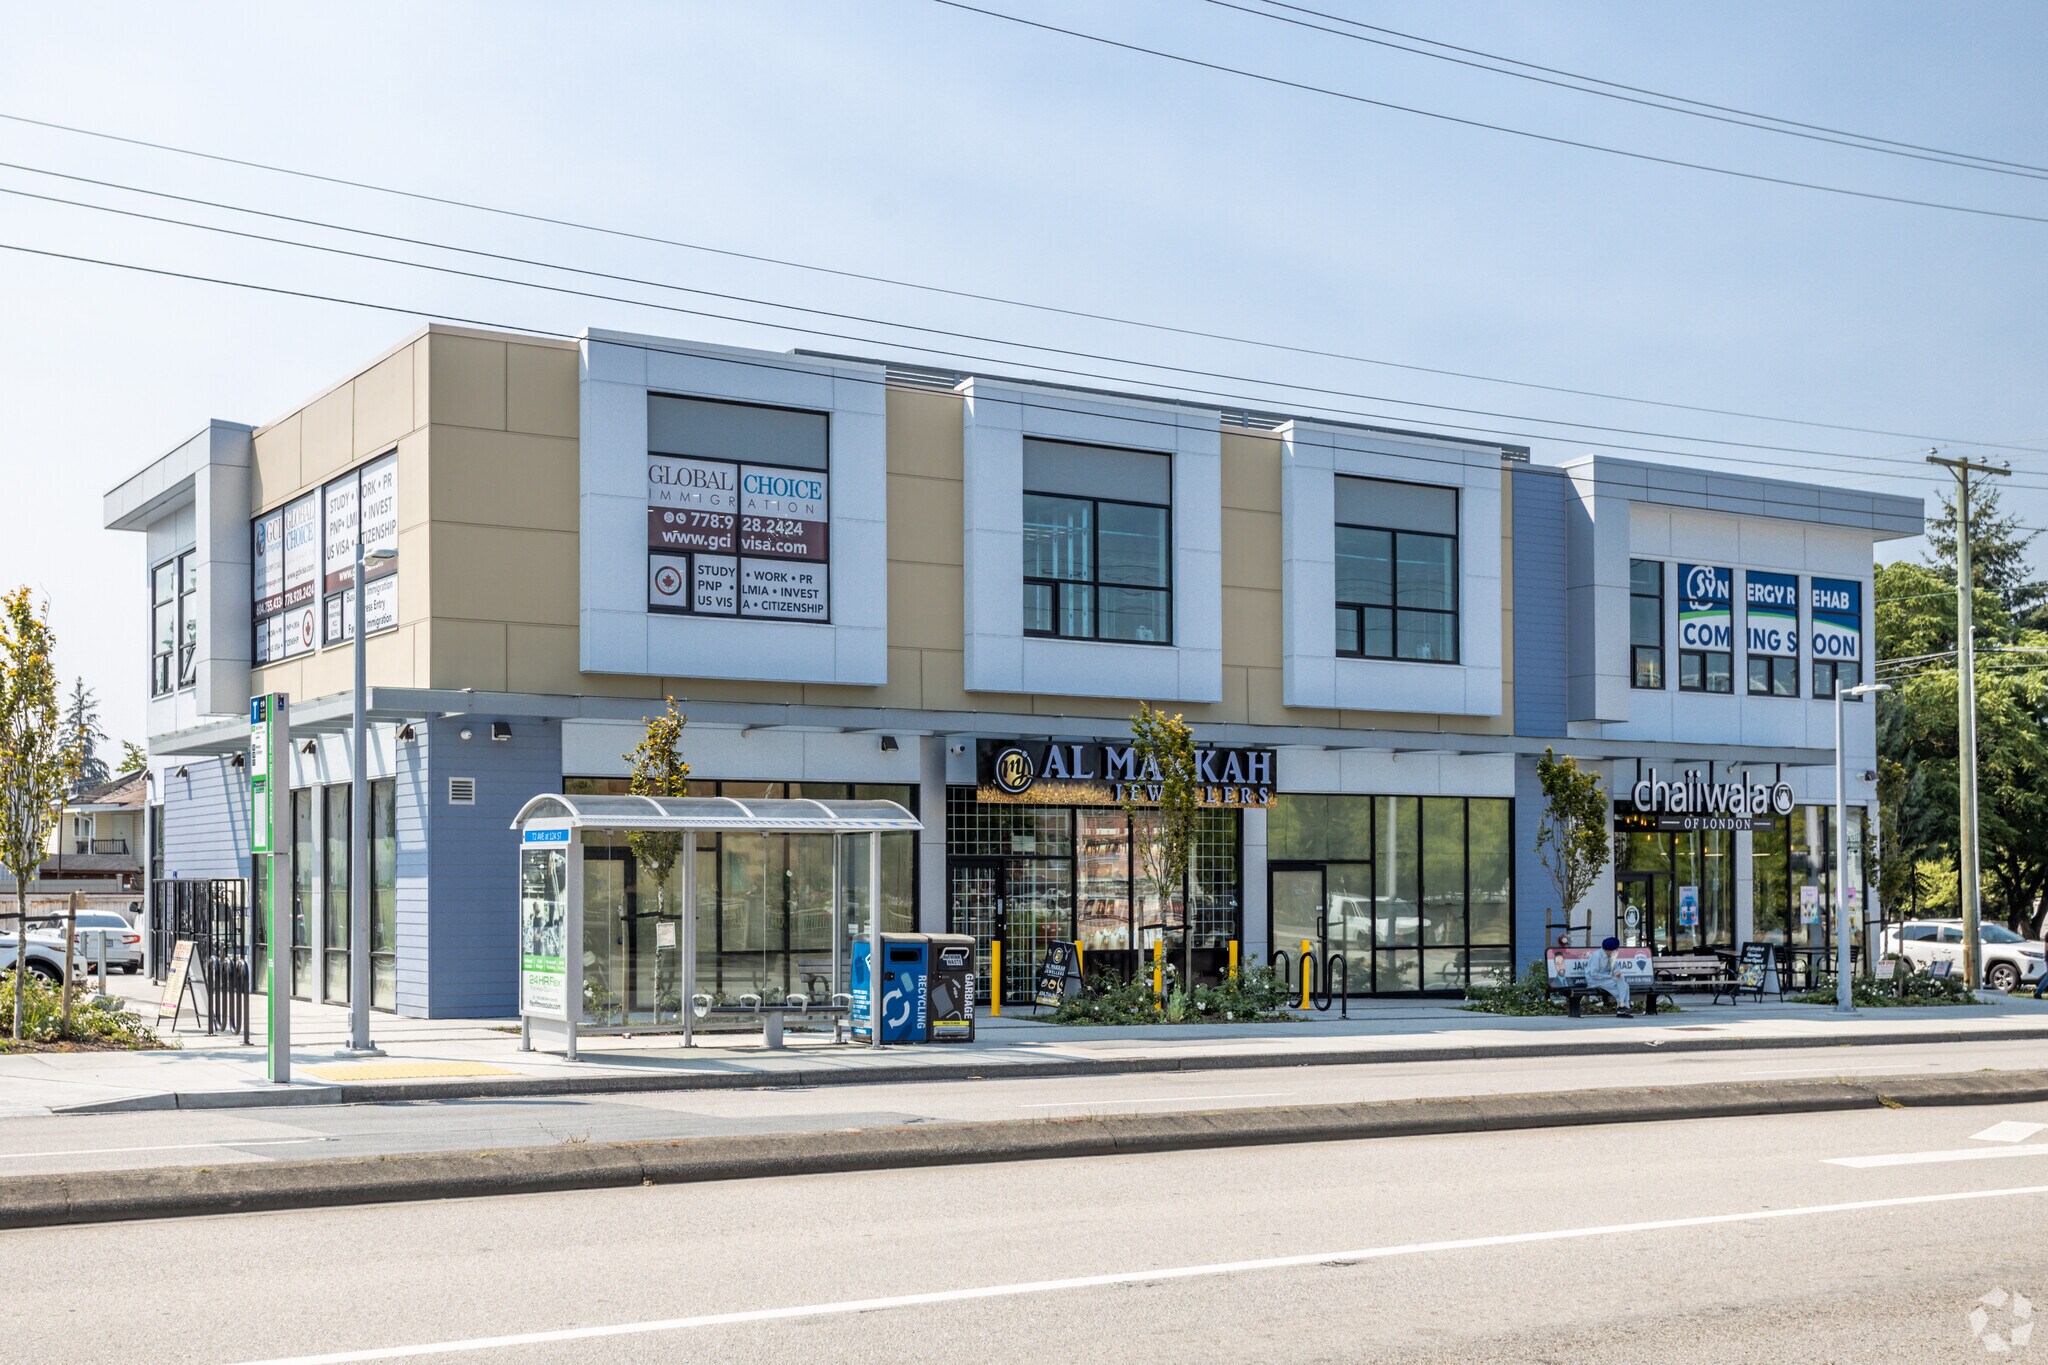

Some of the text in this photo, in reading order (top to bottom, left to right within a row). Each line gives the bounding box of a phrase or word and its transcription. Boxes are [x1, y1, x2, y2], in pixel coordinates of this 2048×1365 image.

[330, 492, 350, 514] STUDY
[383, 472, 392, 490] PR
[648, 464, 822, 500] GLOBAL CHOICE
[346, 511, 360, 529] LMI
[368, 496, 392, 520] INVEST
[649, 489, 814, 513] IMMIGRATION
[285, 501, 315, 530] GLOBAL
[690, 511, 803, 536] 778.928.2424
[266, 518, 281, 544] GCI
[286, 522, 314, 551] CHOICE
[662, 530, 807, 554] www.gcivisa.com
[326, 544, 335, 560] US
[335, 538, 350, 556] VISA
[698, 564, 813, 585] STUDY WORK PR
[698, 580, 819, 599] PNP LMIA INVEST
[1787, 587, 1850, 610] REHAB
[373, 599, 386, 611] Entry
[698, 595, 824, 614] US VISA CITIZENSHIP
[1683, 622, 1855, 657] COMING SOON
[1041, 744, 1094, 779] AL
[1113, 784, 1269, 805] JEWLERS
[1634, 768, 1768, 815] chaiiwala
[1684, 817, 1751, 830] OF LONDON
[917, 974, 927, 1030] RECYCLING
[963, 973, 974, 1020] GARBAGE
